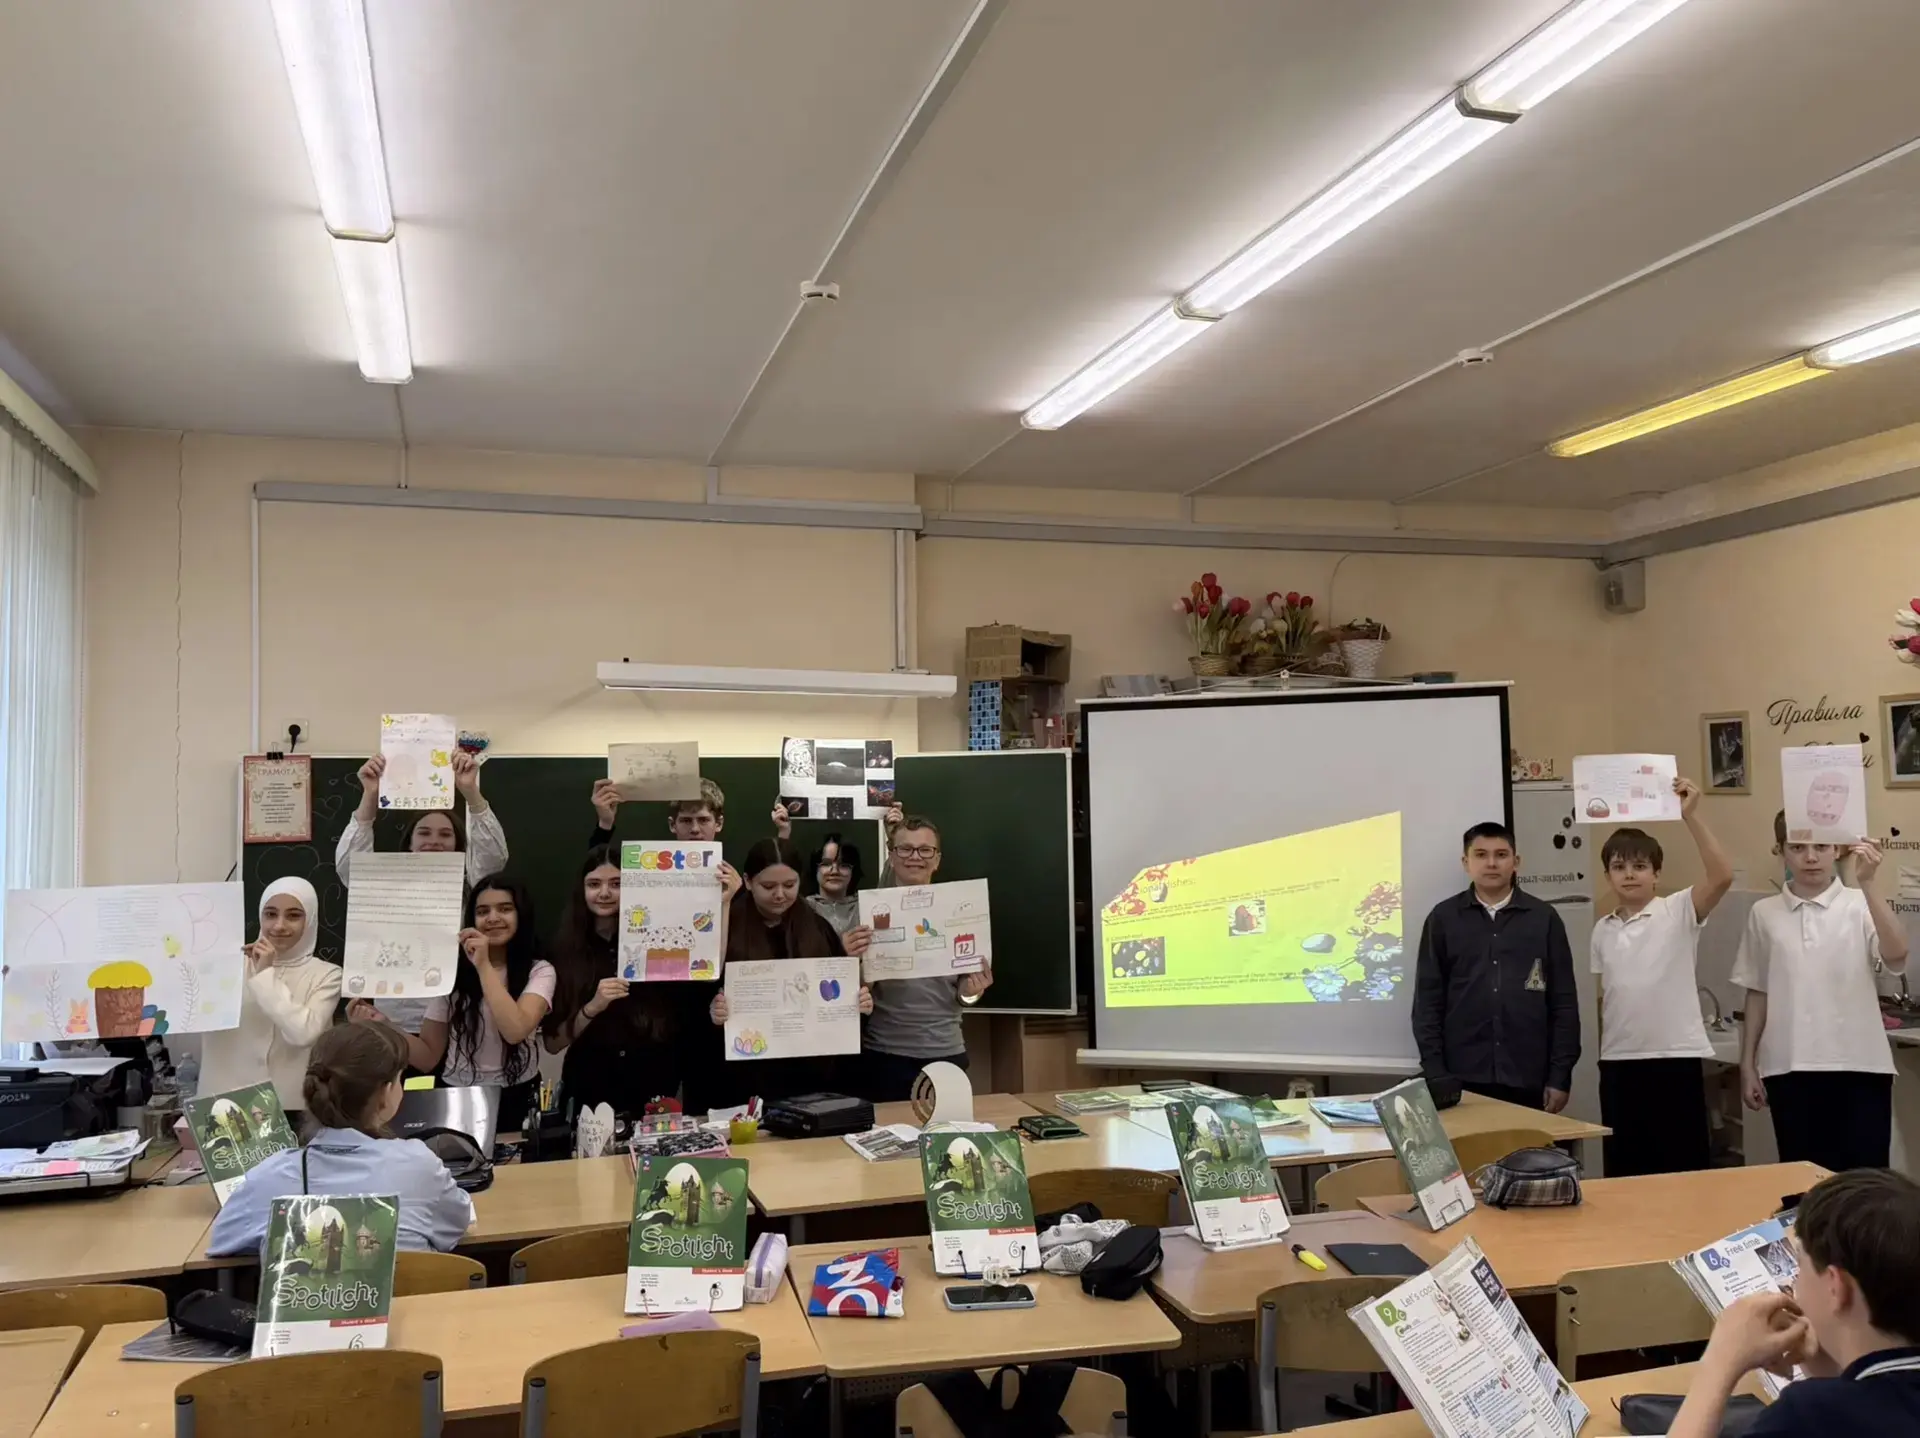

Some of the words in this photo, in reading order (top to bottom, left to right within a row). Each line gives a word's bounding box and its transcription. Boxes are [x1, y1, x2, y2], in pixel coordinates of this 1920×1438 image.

[1767, 695, 1863, 735] Правила
[257, 767, 297, 776] ГРАМОТА
[622, 845, 714, 871] Easter
[1517, 872, 1575, 885] рыл-закрой
[958, 942, 971, 955] 12
[1193, 1160, 1267, 1190] Spotlight
[936, 1190, 1024, 1223] Spotlight
[1259, 1207, 1272, 1224] 6
[639, 1222, 734, 1261] Spotlight
[1009, 1240, 1021, 1259] 6
[1724, 1244, 1745, 1256] Free
[1742, 1237, 1761, 1250] time
[273, 1277, 380, 1312] Spotlight
[710, 1281, 723, 1300] 6
[1400, 1292, 1421, 1308] Let's
[1382, 1307, 1393, 1322] 9
[348, 1333, 364, 1350] 6
